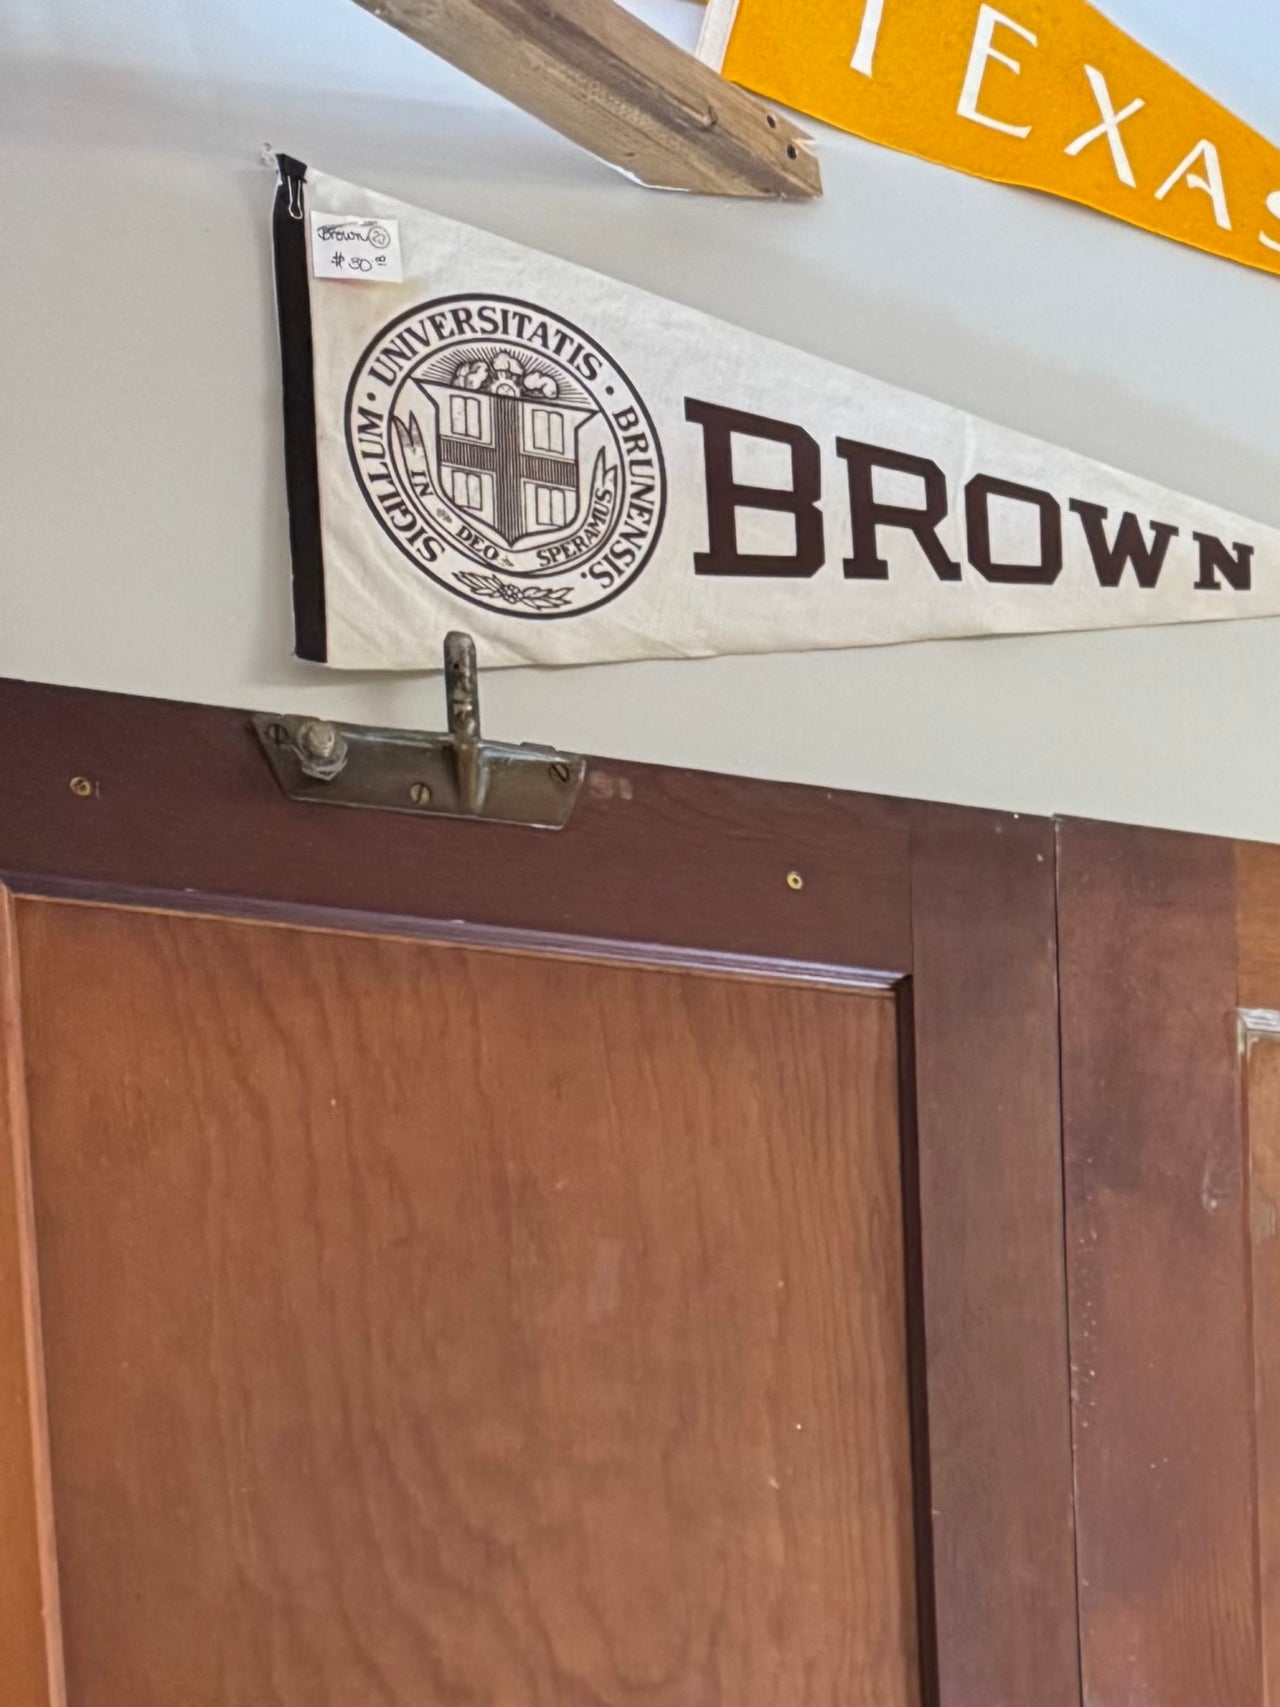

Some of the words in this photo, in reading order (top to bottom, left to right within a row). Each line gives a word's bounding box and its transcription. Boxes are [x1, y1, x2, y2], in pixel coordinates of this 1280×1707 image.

[370, 305, 605, 388] UNIVERSITATIS
[354, 405, 445, 564] SIGILLUM
[411, 468, 433, 498] IN
[455, 524, 499, 563] DEO
[535, 487, 614, 567] SPERAMUS
[684, 396, 1255, 593] BROWN
